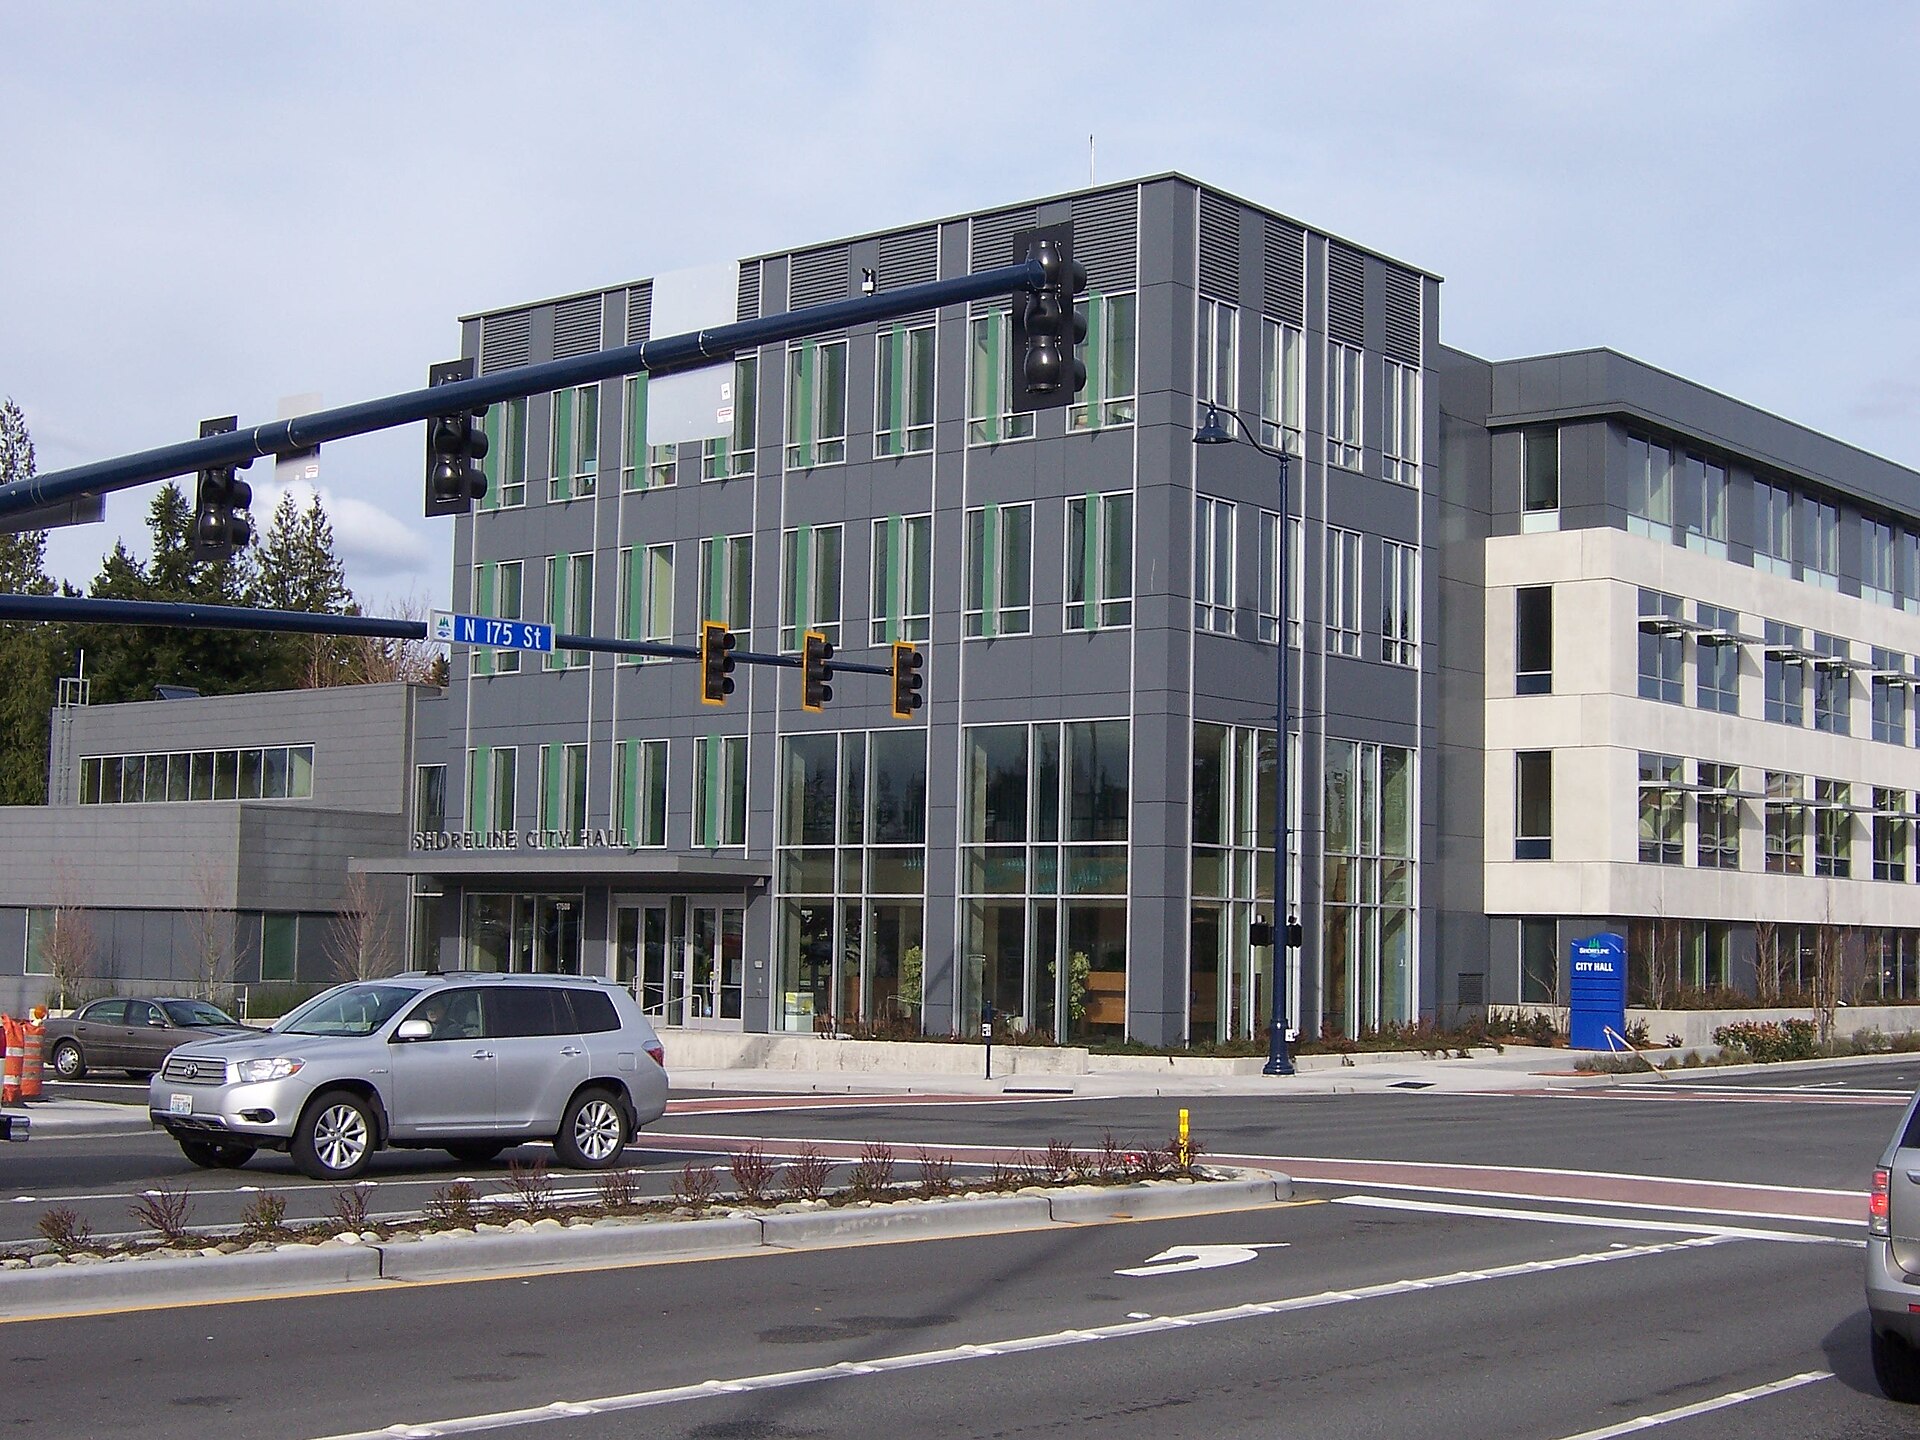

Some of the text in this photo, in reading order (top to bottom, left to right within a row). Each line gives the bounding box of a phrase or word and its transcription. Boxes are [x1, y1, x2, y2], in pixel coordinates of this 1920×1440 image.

[464, 618, 542, 649] N 175 St
[412, 828, 631, 850] SHORELINE CITY HALL
[1575, 961, 1614, 972] CITY HALL
